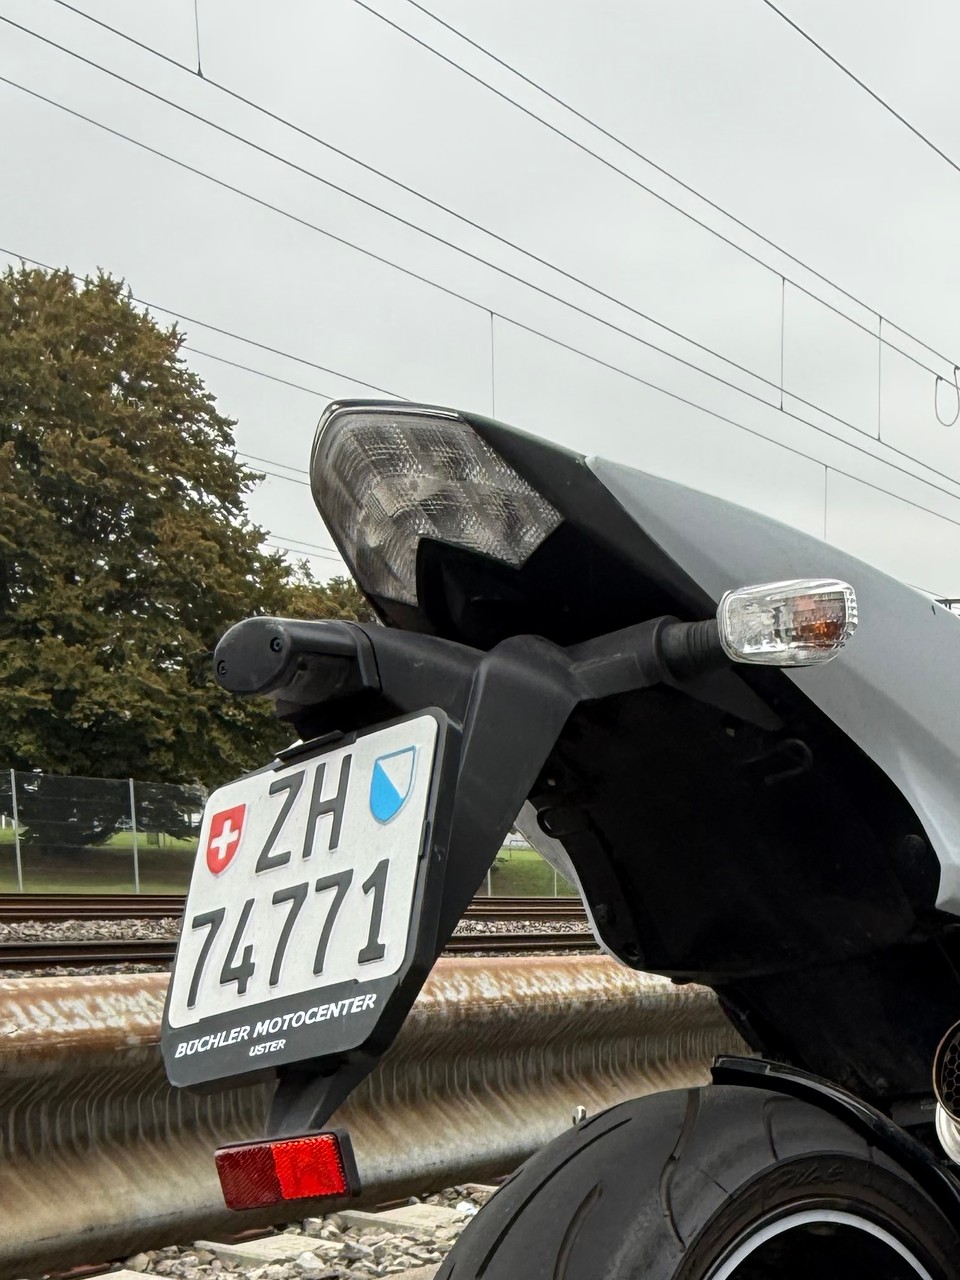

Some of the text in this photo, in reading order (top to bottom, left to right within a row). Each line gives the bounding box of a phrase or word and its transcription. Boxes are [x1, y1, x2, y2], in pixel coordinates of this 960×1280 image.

[255, 752, 353, 874] ZH
[186, 857, 390, 1011] 74771
[248, 1038, 287, 1058] USTER
[252, 993, 377, 1038] MOTOCENTER
